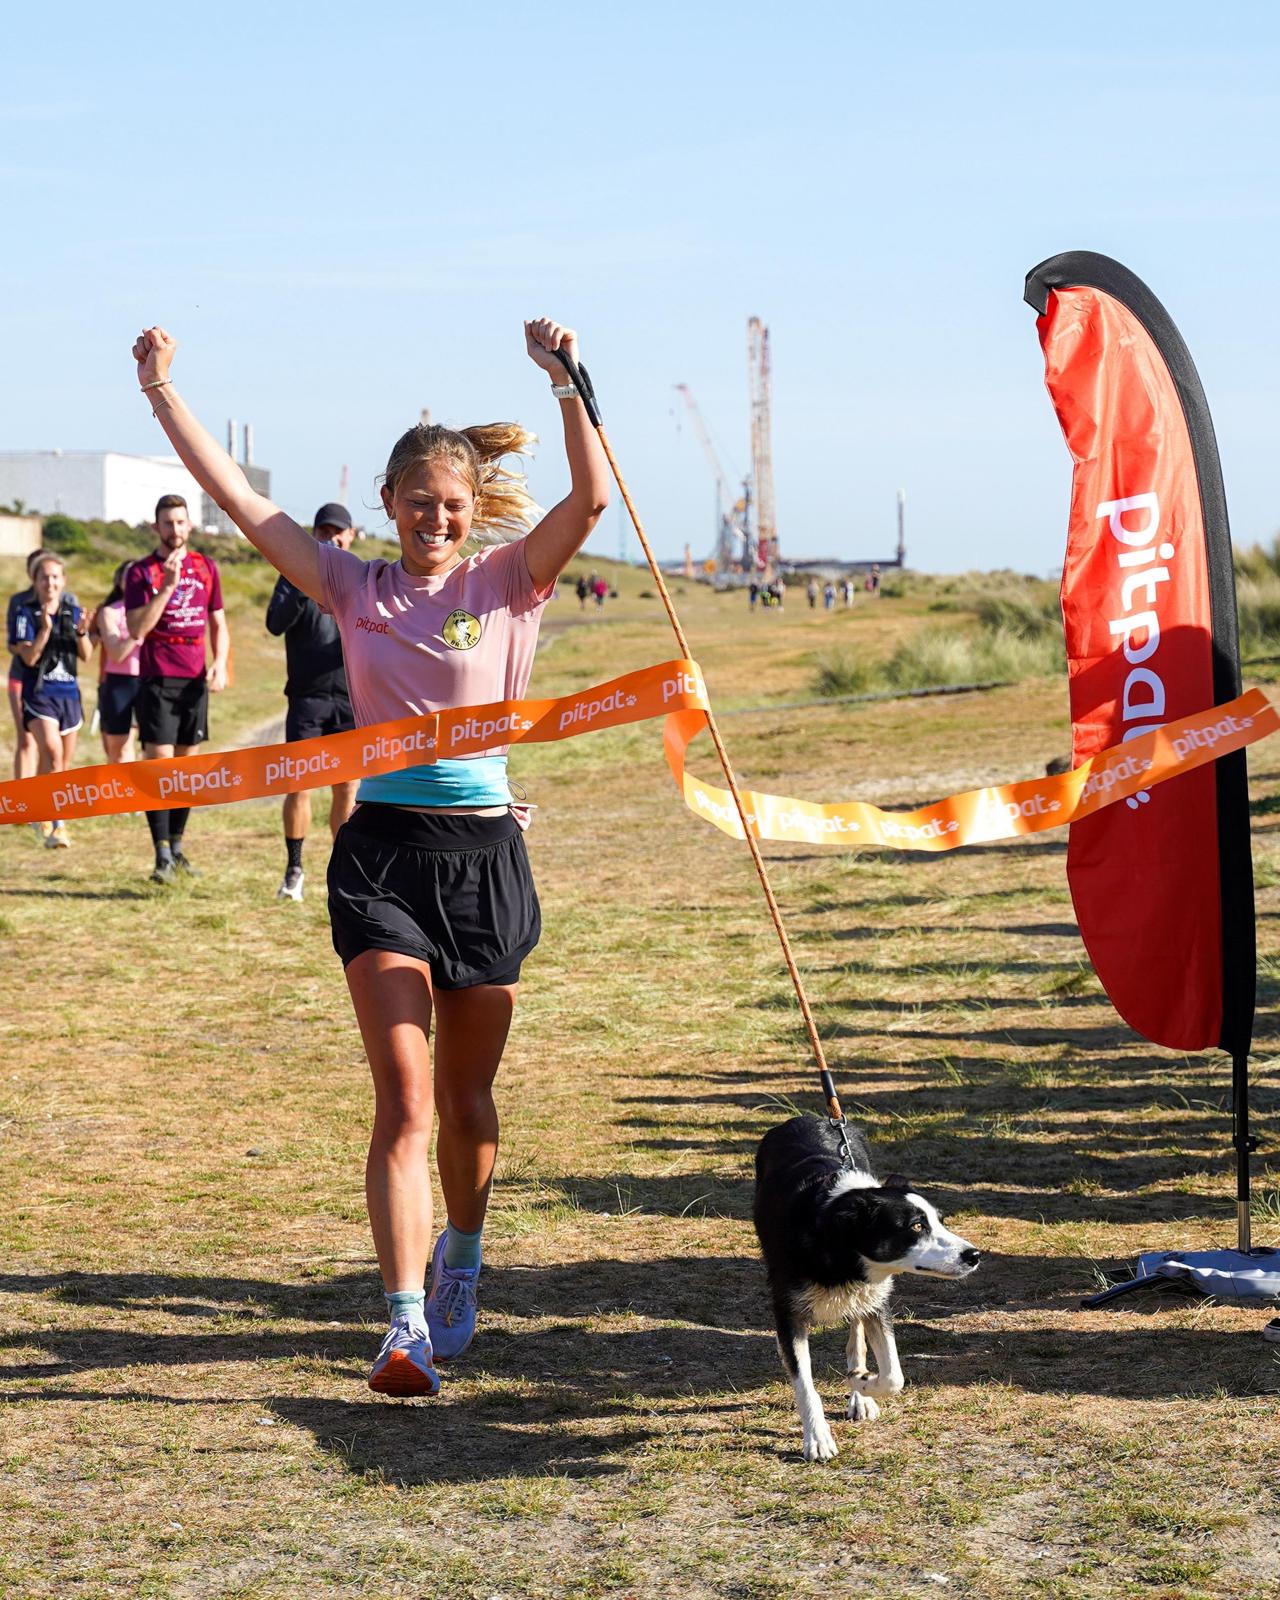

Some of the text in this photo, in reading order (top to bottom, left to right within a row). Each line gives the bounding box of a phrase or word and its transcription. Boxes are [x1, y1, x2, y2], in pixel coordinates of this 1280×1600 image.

[355, 616, 389, 635] pitpat
[52, 778, 124, 812] pitpat
[158, 766, 231, 799] pitpat
[265, 750, 330, 785] pitpat
[362, 730, 426, 767] pitpat
[451, 712, 521, 747] pitpat
[559, 689, 626, 731] pitpat
[1171, 715, 1242, 760] pitpat
